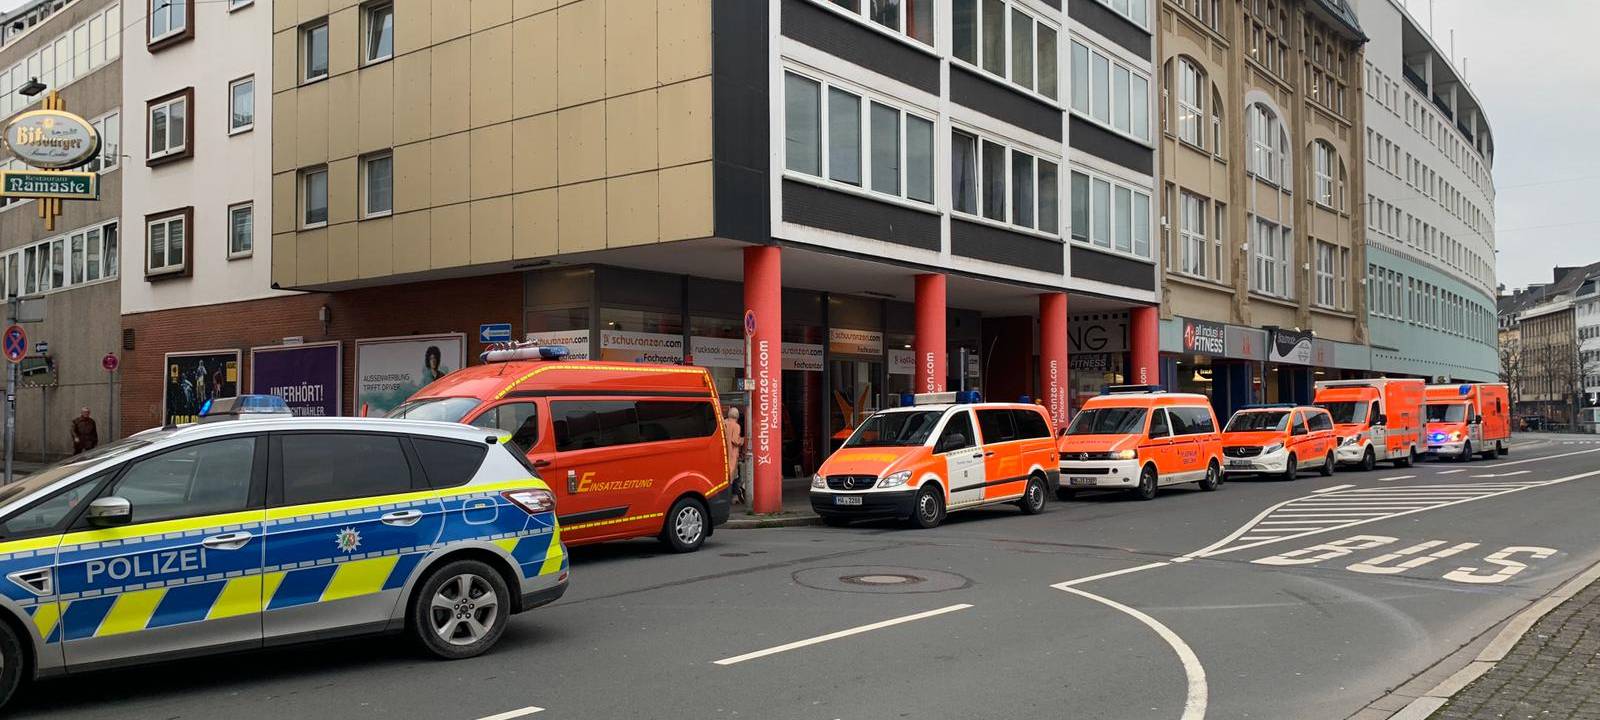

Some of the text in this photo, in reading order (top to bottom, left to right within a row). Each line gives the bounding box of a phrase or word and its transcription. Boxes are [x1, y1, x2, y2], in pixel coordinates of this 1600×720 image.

[10, 178, 85, 193] Namaste
[1194, 335, 1224, 353] FITNESS
[270, 381, 324, 402] UNERHÖRT!
[758, 340, 769, 452] schulranzen.com
[86, 548, 207, 584] POLIZEI
[1250, 535, 1558, 584] BUS
